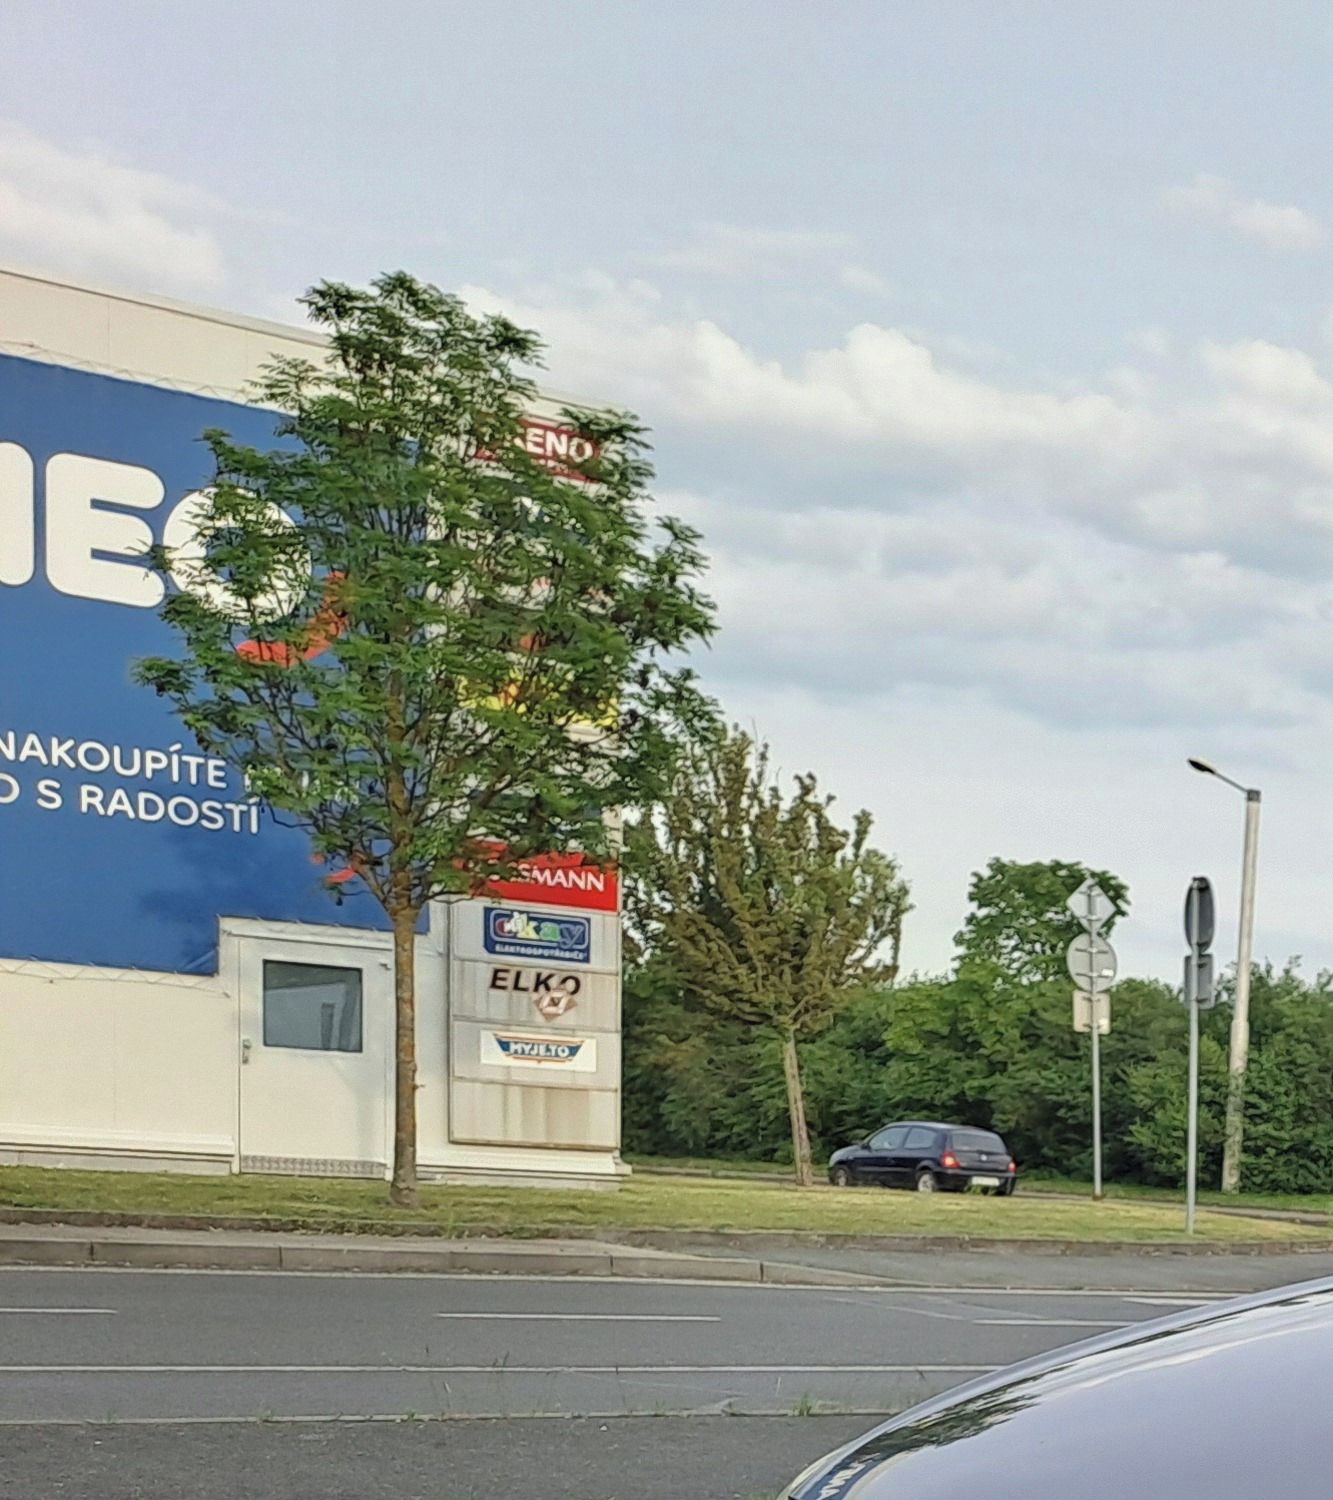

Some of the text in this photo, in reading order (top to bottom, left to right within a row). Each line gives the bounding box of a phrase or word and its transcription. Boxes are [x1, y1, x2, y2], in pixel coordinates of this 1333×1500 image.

[37, 779, 63, 810] S
[80, 784, 260, 834] RADOSTÍ
[489, 968, 581, 996] ELKO
